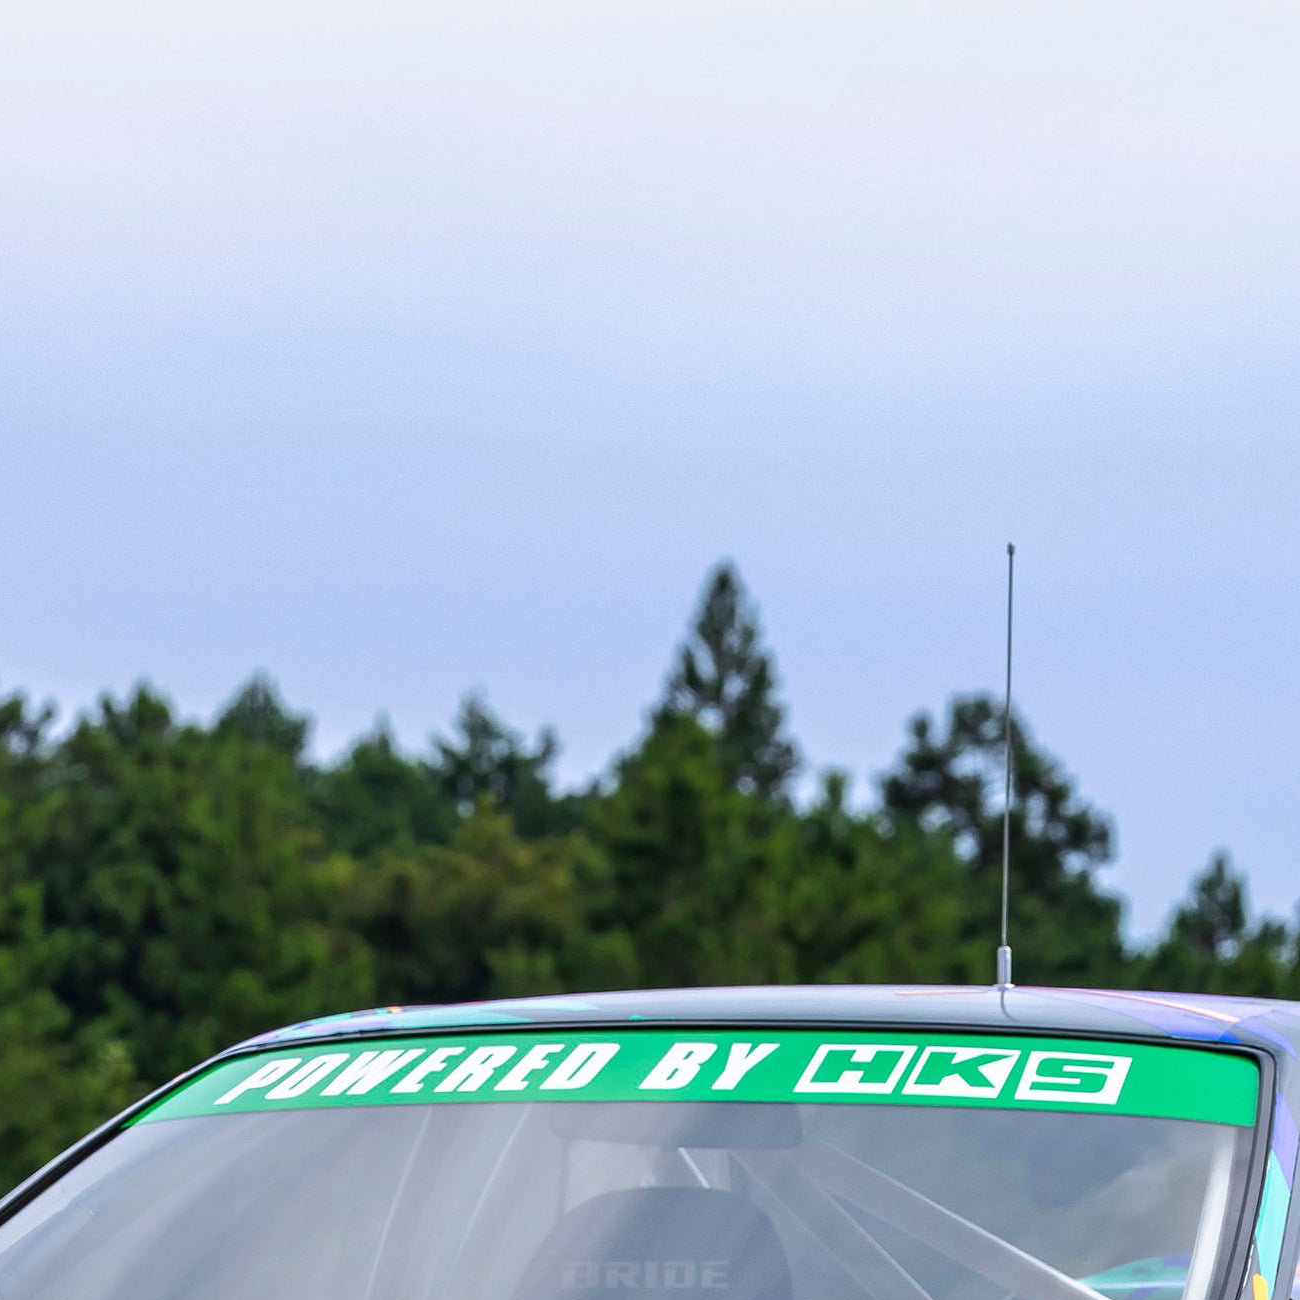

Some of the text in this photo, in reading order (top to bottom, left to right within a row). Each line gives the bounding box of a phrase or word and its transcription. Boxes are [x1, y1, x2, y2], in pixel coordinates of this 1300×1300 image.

[214, 1041, 1133, 1107] POWERED BY HKS
[561, 1261, 731, 1289] BRIDE
